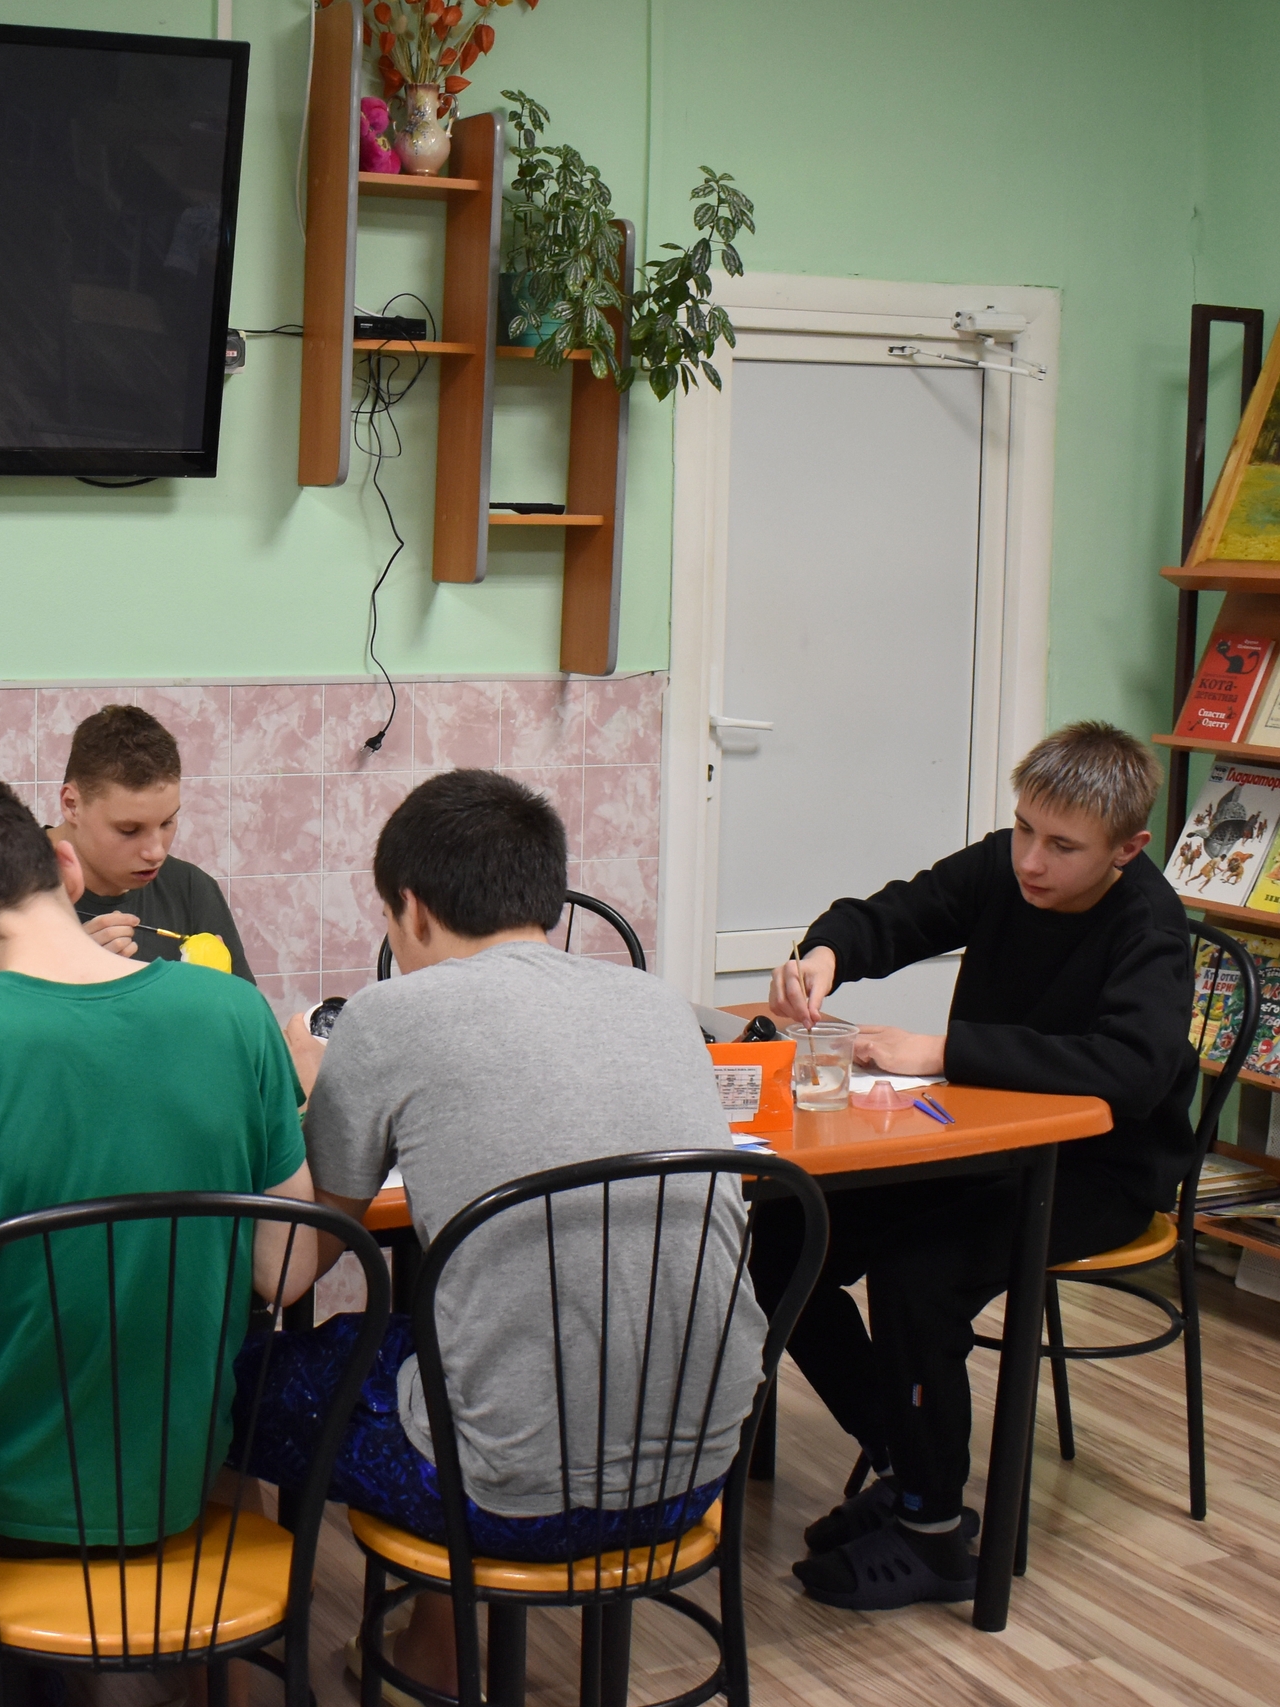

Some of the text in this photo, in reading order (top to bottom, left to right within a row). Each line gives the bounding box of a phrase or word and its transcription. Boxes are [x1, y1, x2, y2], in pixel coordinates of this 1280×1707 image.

[1198, 708, 1226, 719] Спасти
[1202, 718, 1230, 730] Одетту
[1226, 767, 1280, 791] Гладиатор
